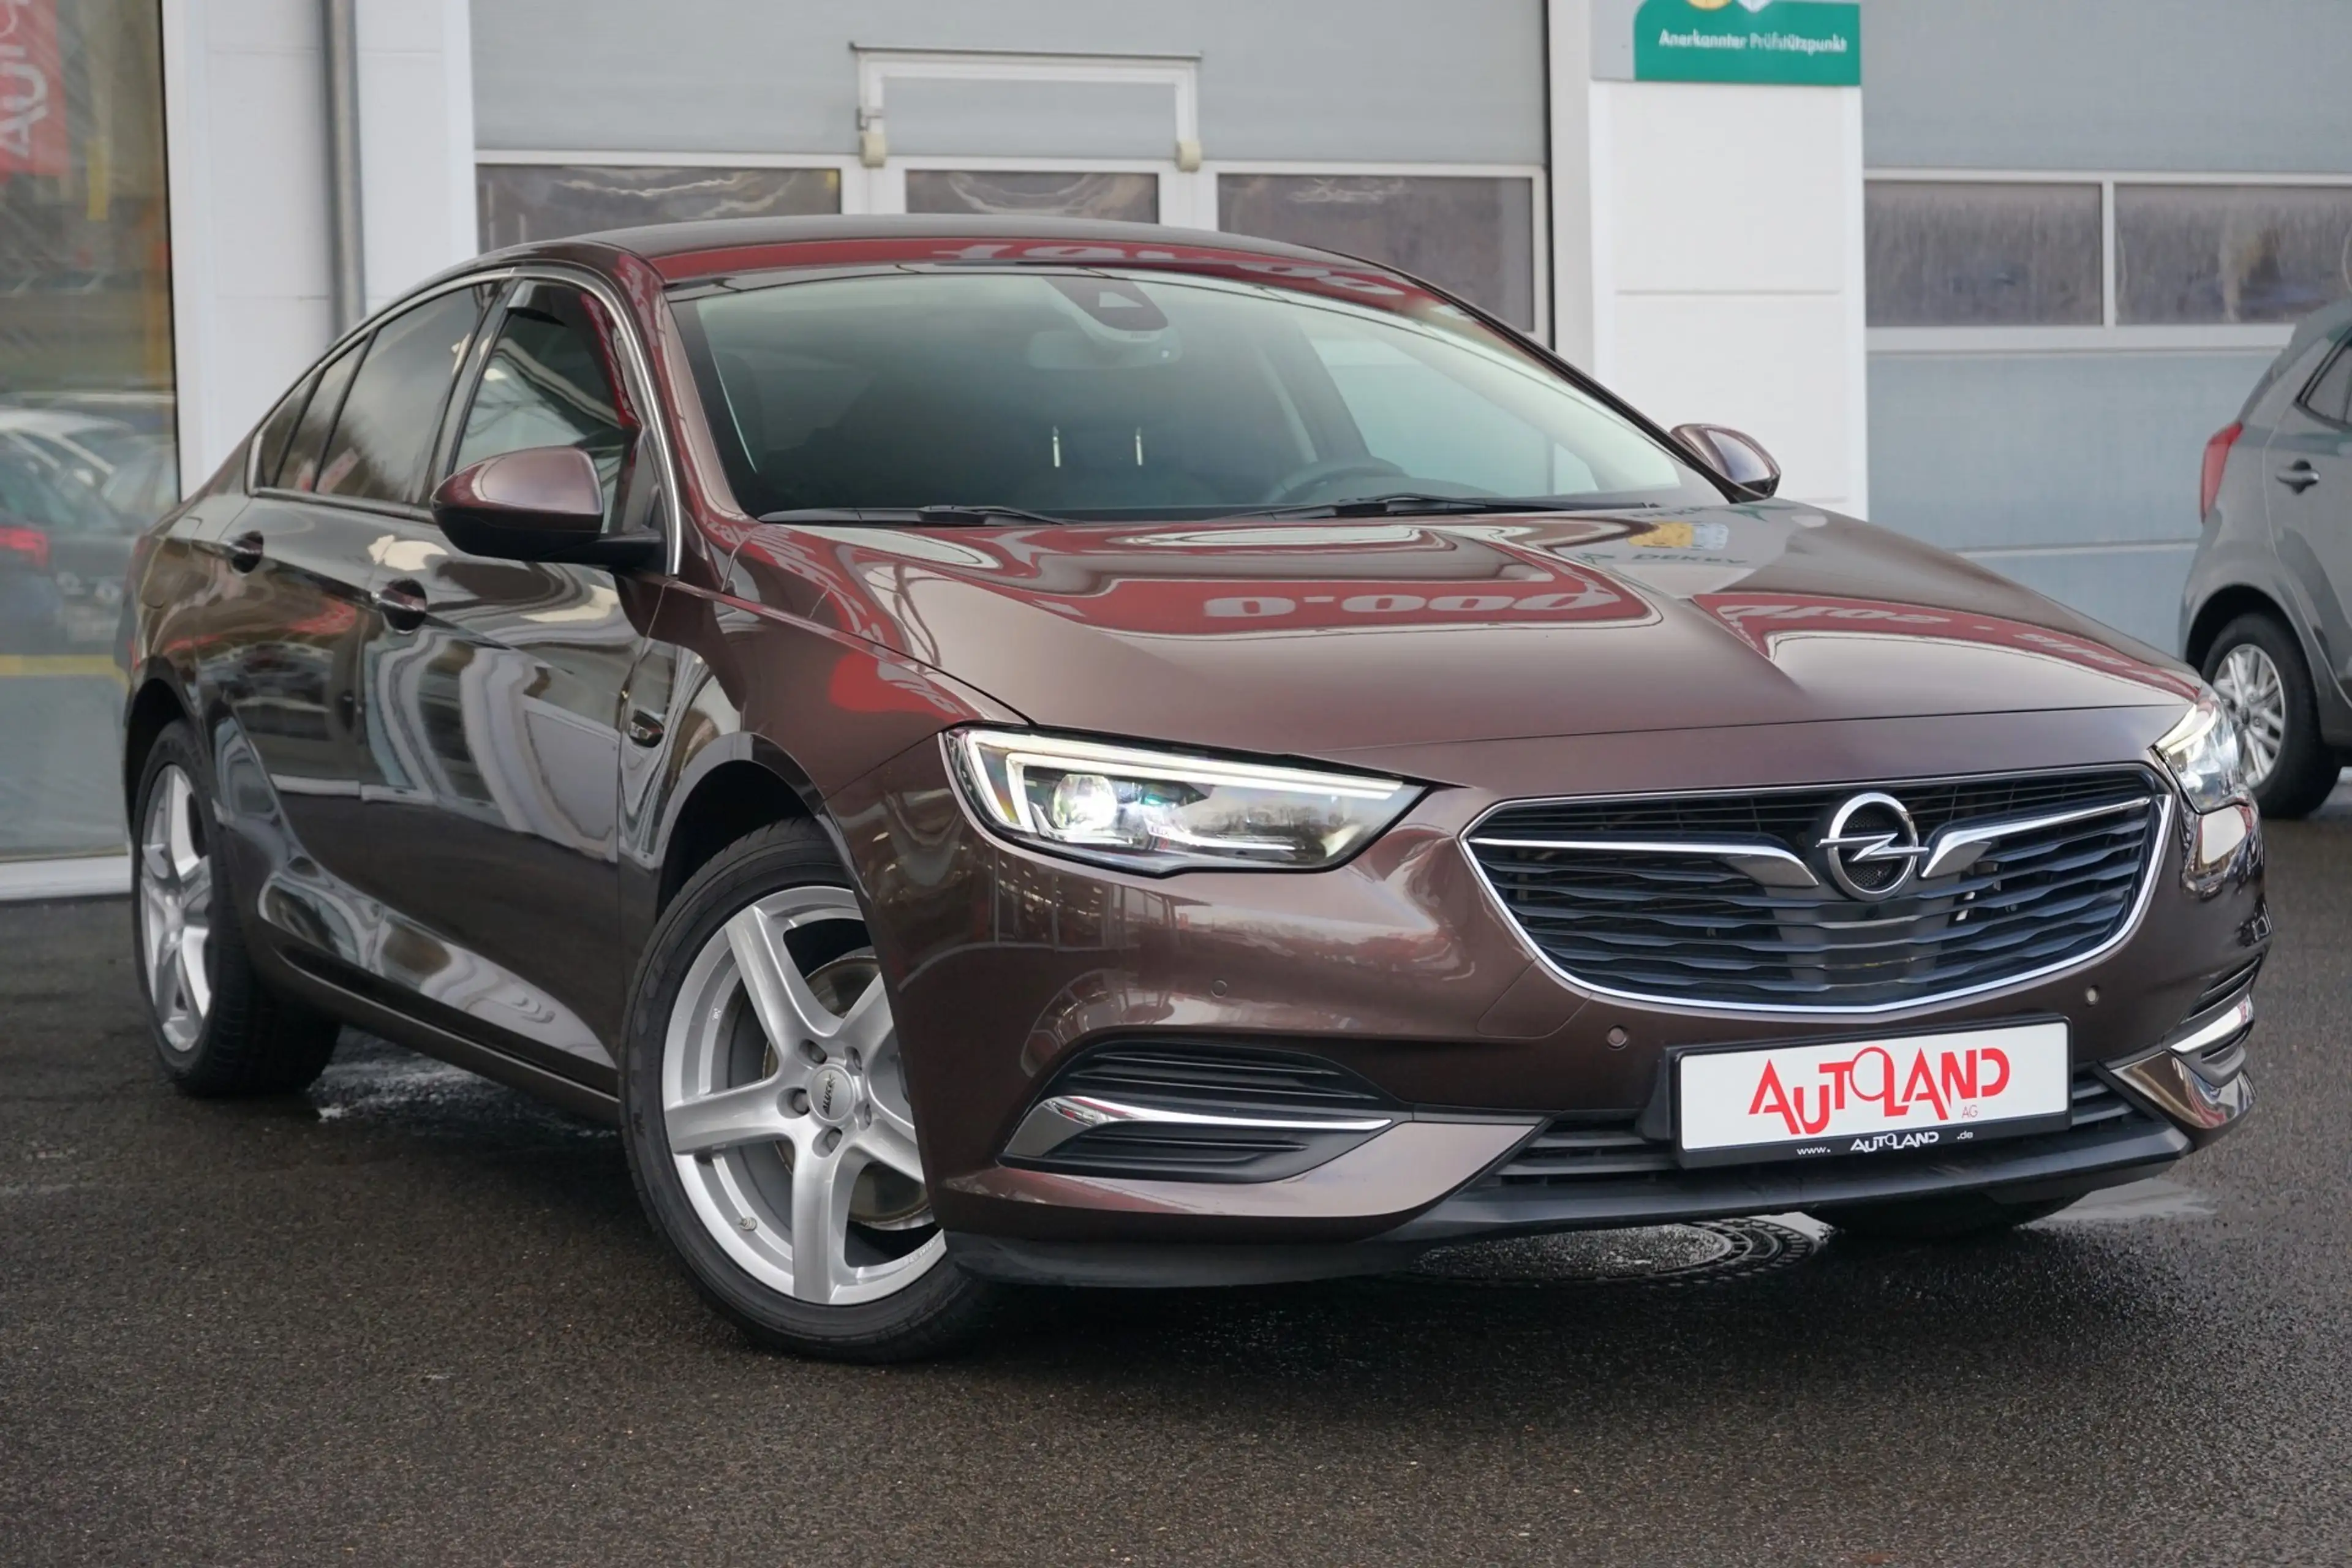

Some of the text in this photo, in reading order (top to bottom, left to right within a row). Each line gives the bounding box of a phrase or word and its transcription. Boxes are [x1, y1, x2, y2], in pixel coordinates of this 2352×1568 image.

[1659, 28, 1847, 56] Anerkannter Prüfstützpunkt
[1749, 1046, 2010, 1135] AUTOLAND
[1961, 1104, 1979, 1119] AG
[1796, 1131, 1973, 1155] www. AUTOLAND .de
